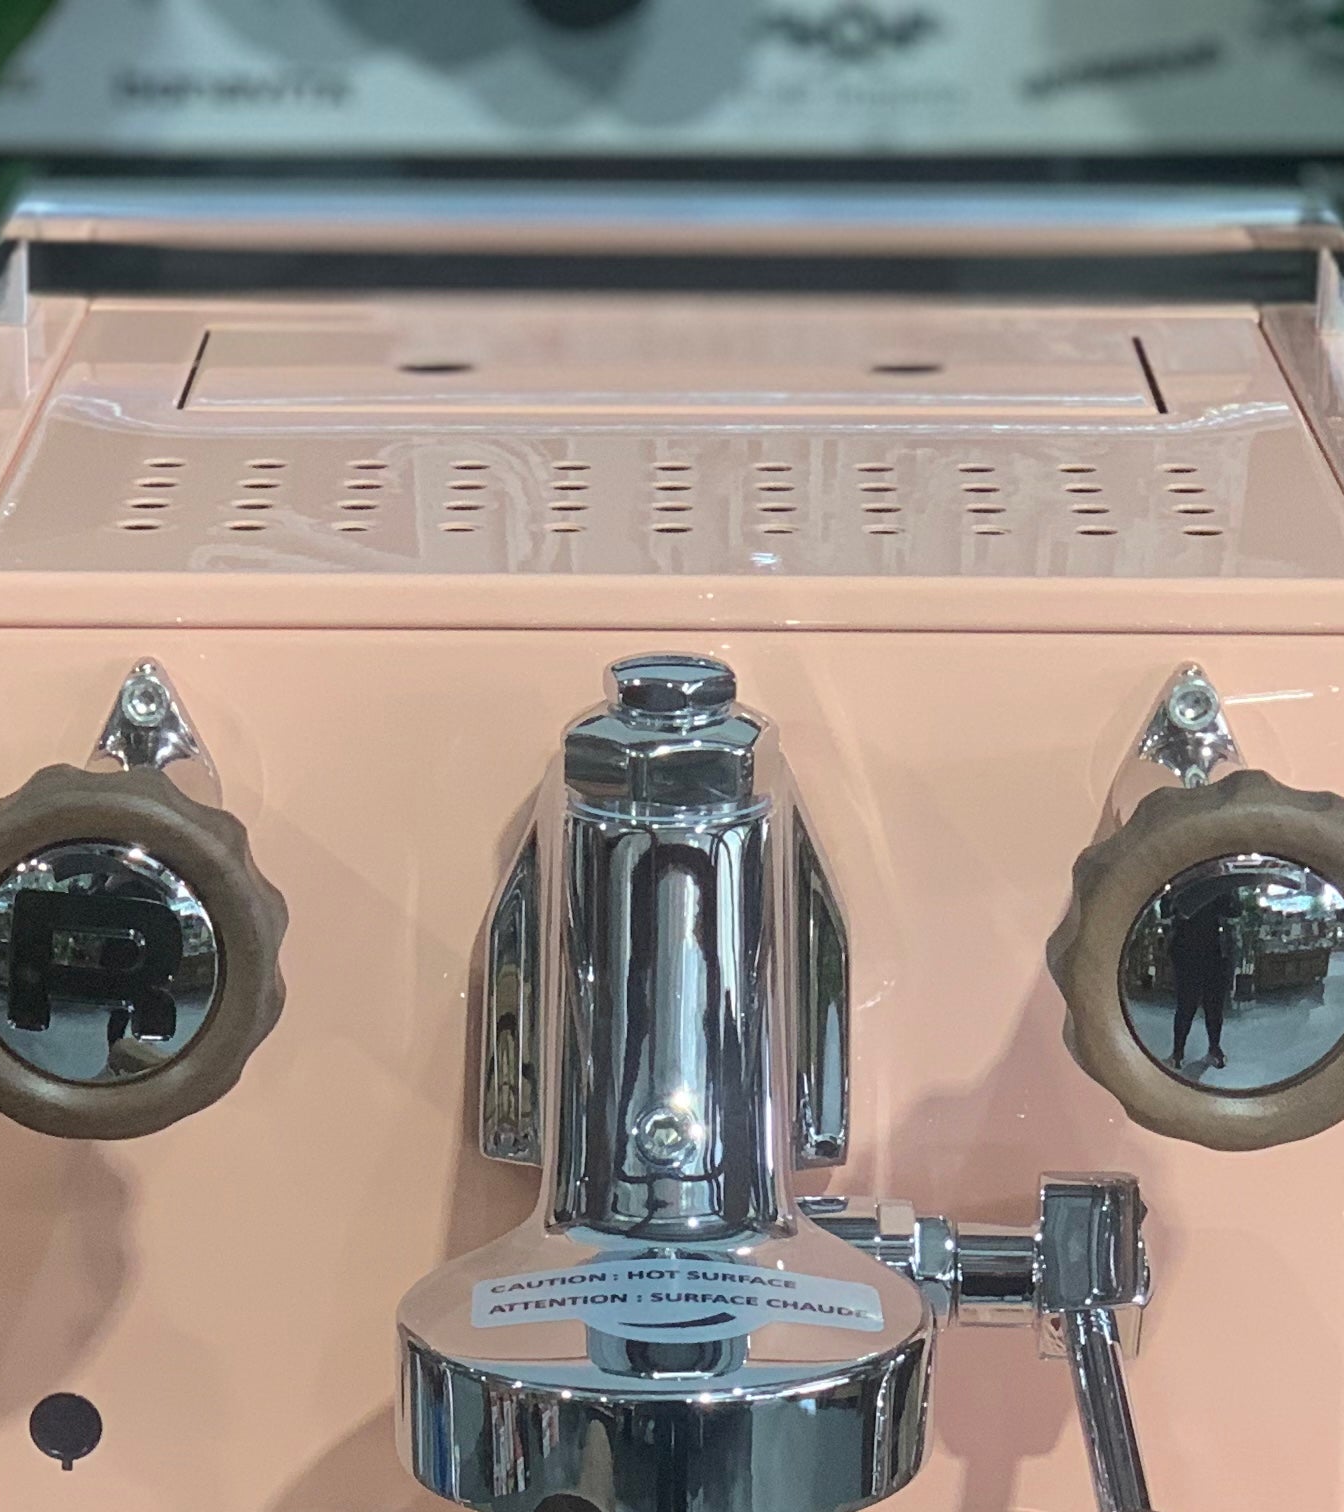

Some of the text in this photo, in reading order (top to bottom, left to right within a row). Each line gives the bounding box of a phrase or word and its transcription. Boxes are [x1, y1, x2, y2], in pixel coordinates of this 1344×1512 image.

[7, 890, 183, 1041] R
[491, 1273, 607, 1293] CAUTION
[627, 1269, 680, 1281] HOT
[686, 1270, 797, 1290] SURFACE
[489, 1292, 628, 1314] ATTENTION
[650, 1292, 759, 1307] SURFACE
